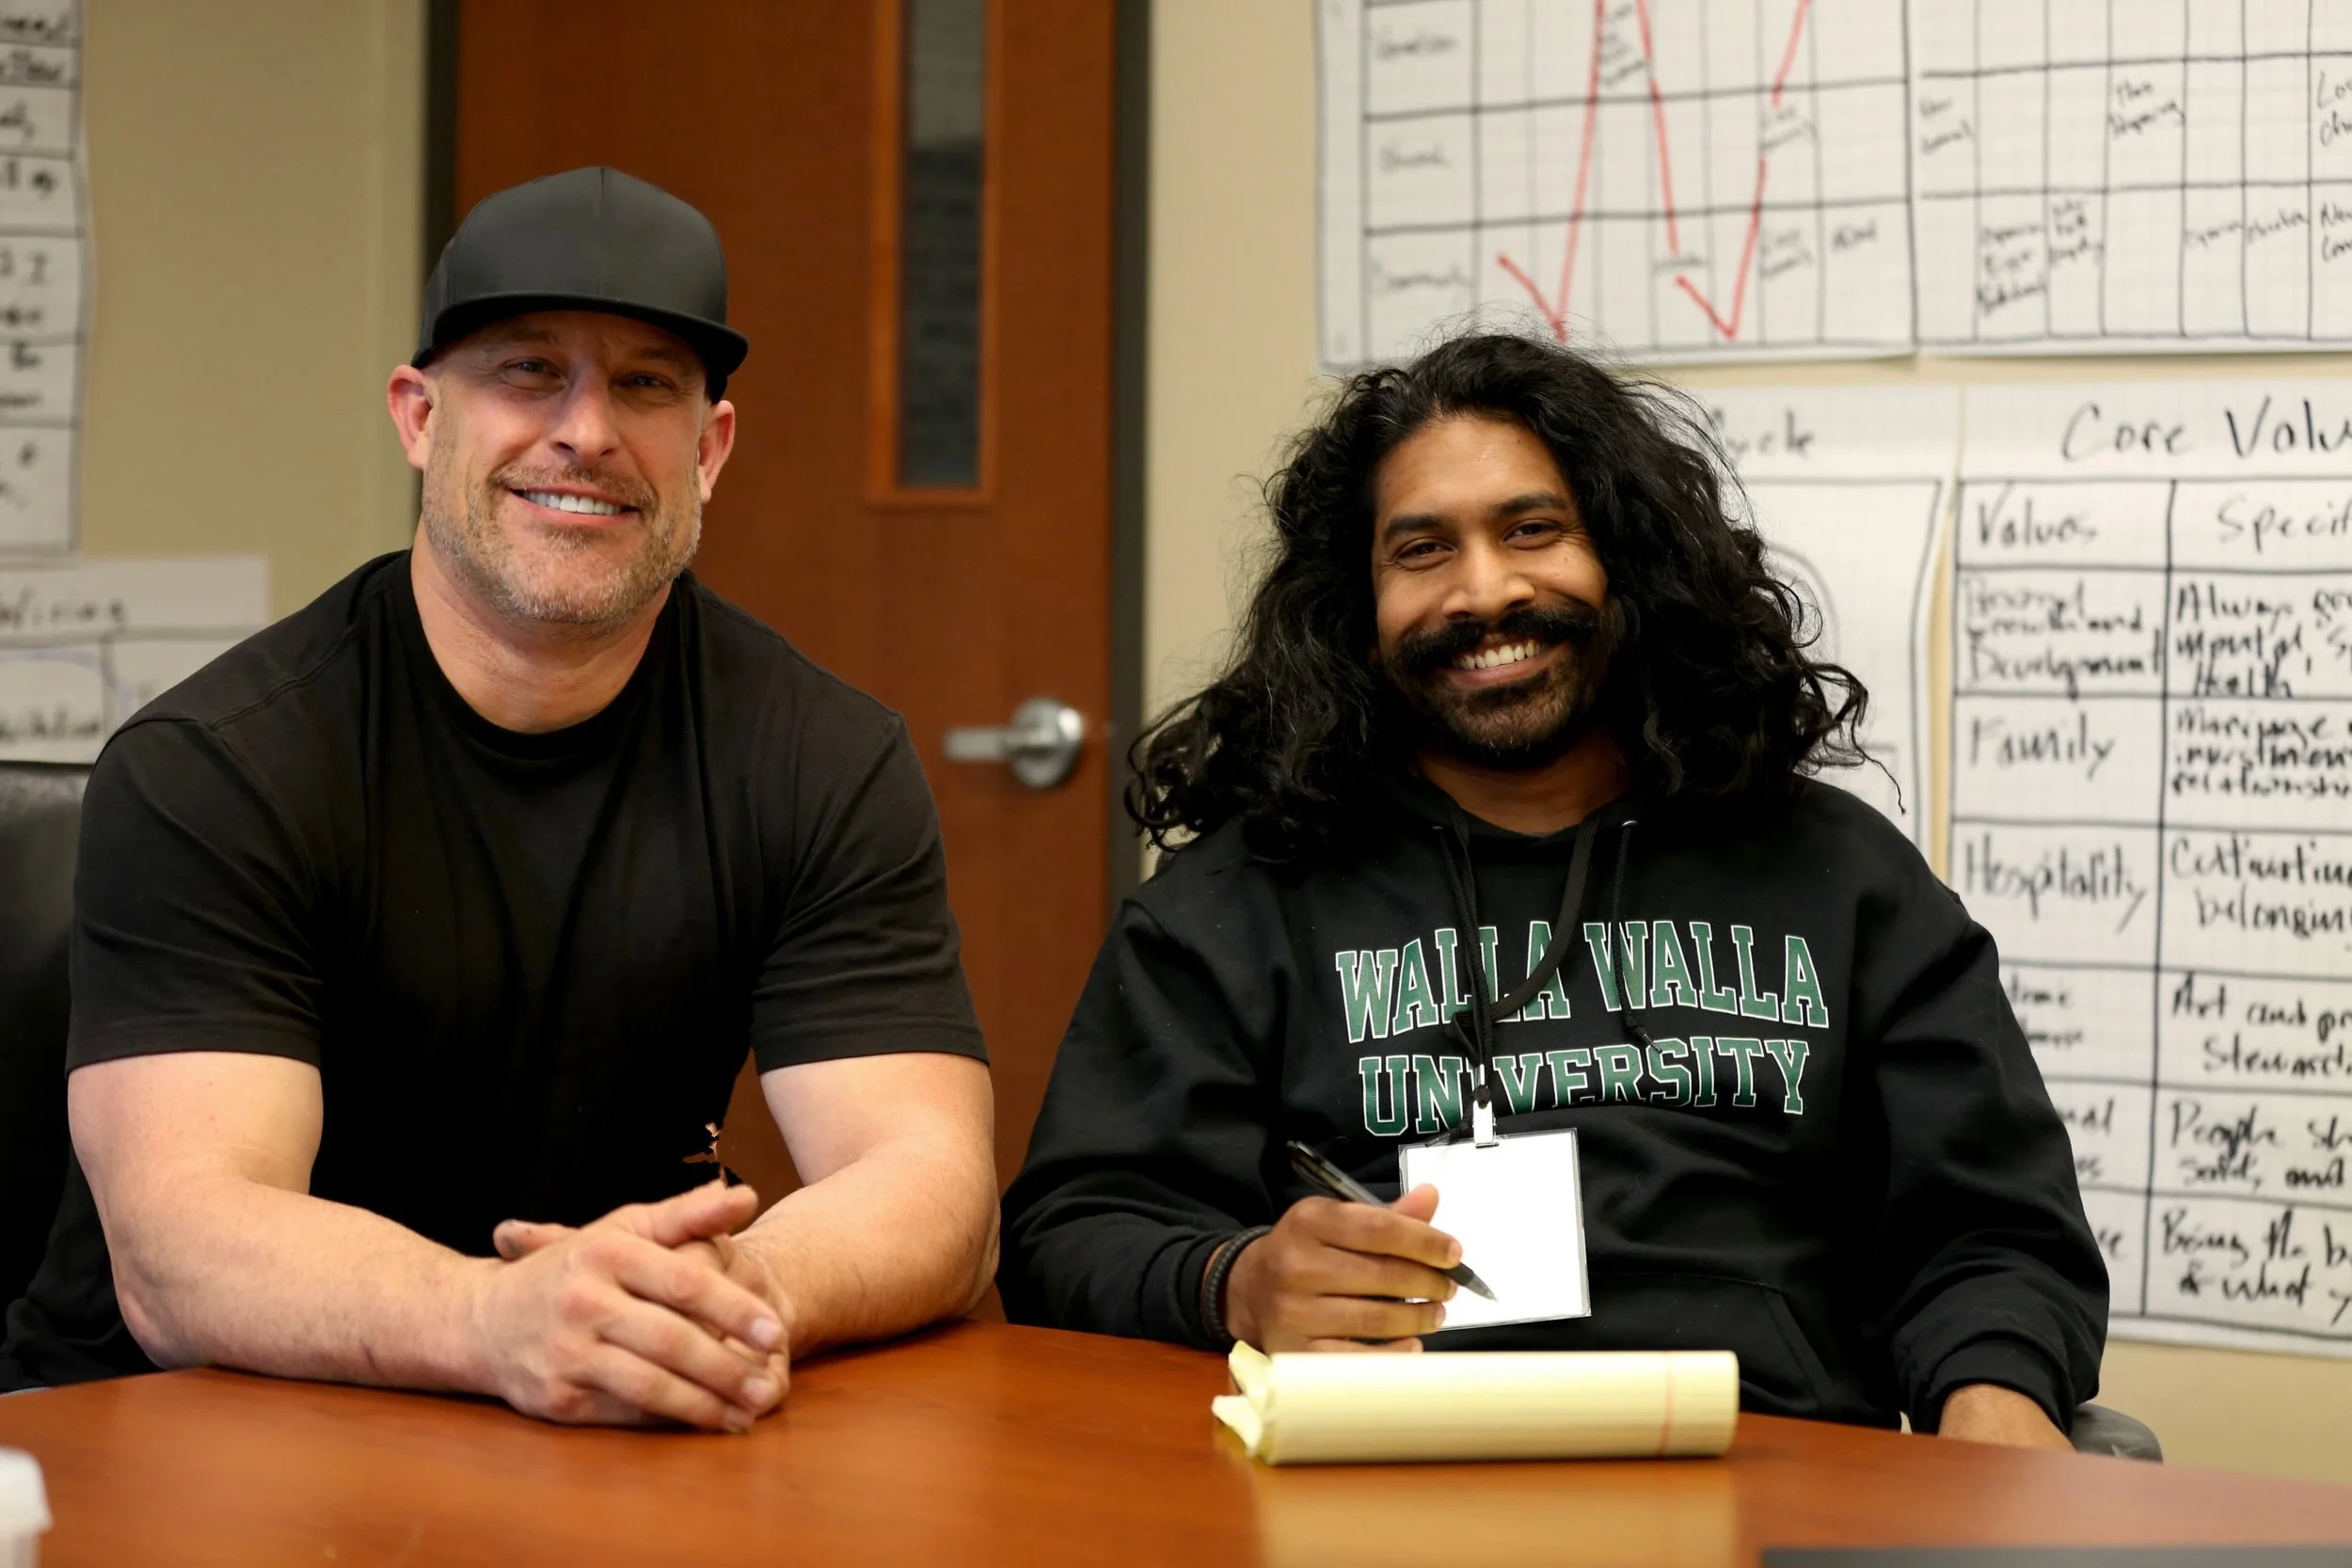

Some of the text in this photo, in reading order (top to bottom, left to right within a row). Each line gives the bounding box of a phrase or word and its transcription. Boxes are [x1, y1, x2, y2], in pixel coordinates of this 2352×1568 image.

[2060, 400, 2186, 462] Core
[1977, 486, 2097, 549] Values
[1970, 708, 2116, 783] Family
[1963, 831, 2149, 937] Hospitality
[1335, 919, 1831, 1043] WALLA WALLA
[2172, 970, 2231, 1019] Art
[1358, 1036, 1811, 1138] UNVERSITY
[2171, 1096, 2286, 1163] People
[2162, 1206, 2252, 1270] Being
